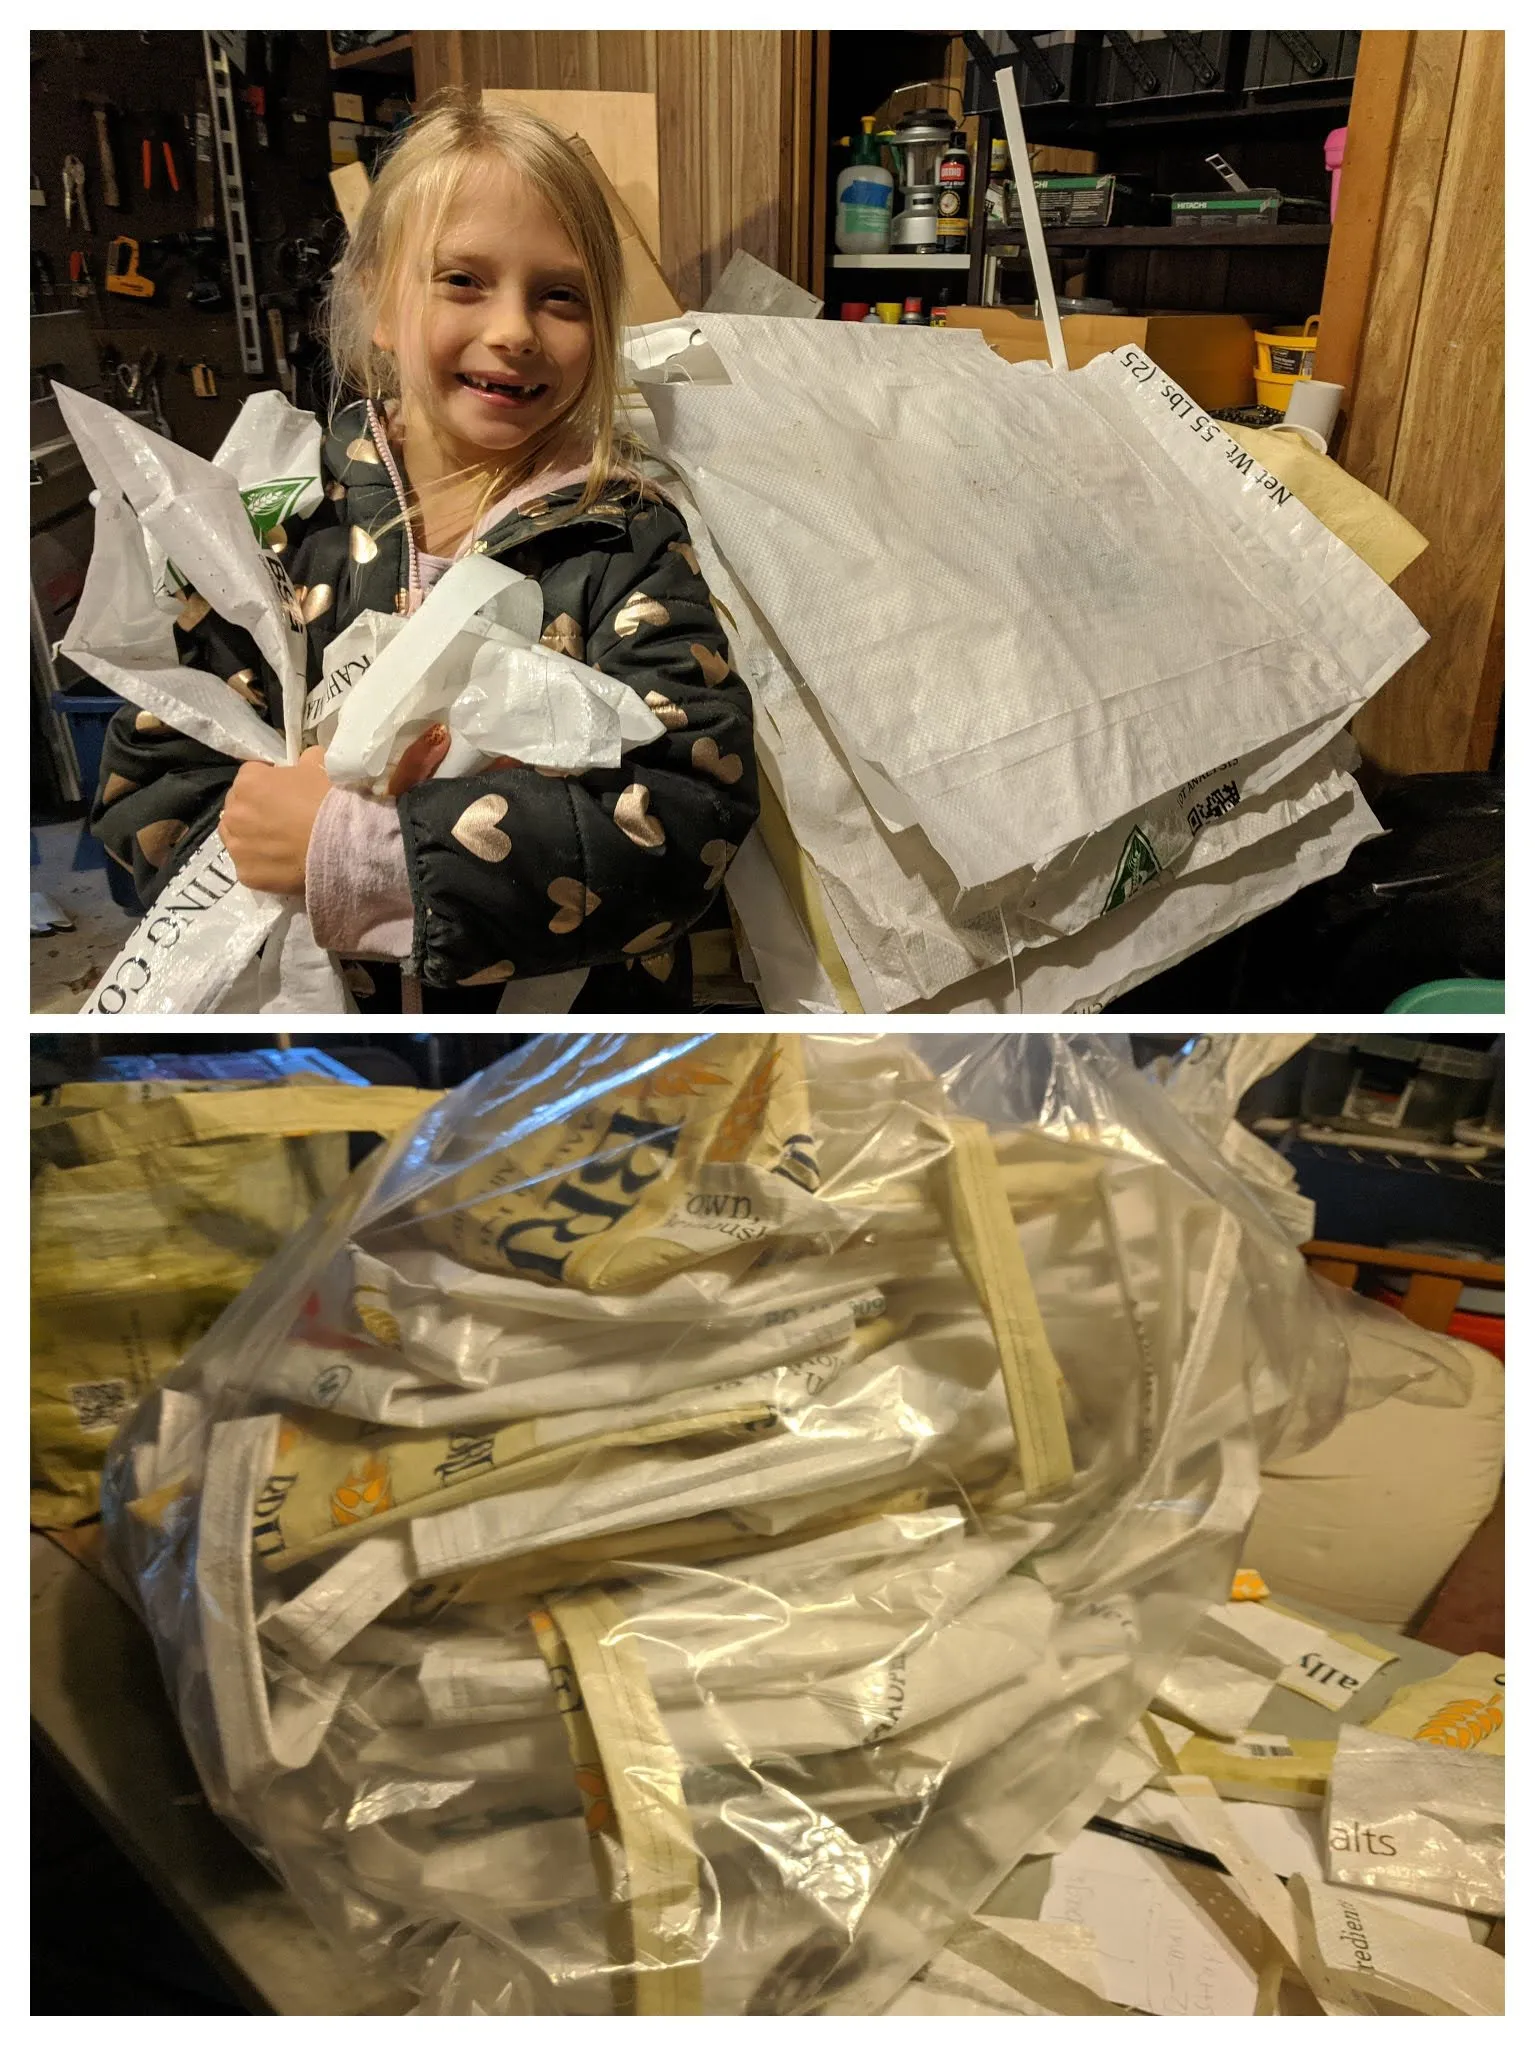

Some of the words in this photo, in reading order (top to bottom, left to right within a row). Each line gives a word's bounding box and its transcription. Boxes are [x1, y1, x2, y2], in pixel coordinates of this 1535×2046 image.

[1177, 201, 1208, 210] HITACHI
[1120, 352, 1157, 383] (25
[1161, 379, 1194, 419] Lbs.
[1190, 416, 1220, 442] 55
[1226, 438, 1255, 475] Wt.
[1255, 469, 1293, 507] Net
[1300, 1653, 1359, 1690] ally
[1329, 1822, 1397, 1857] alts
